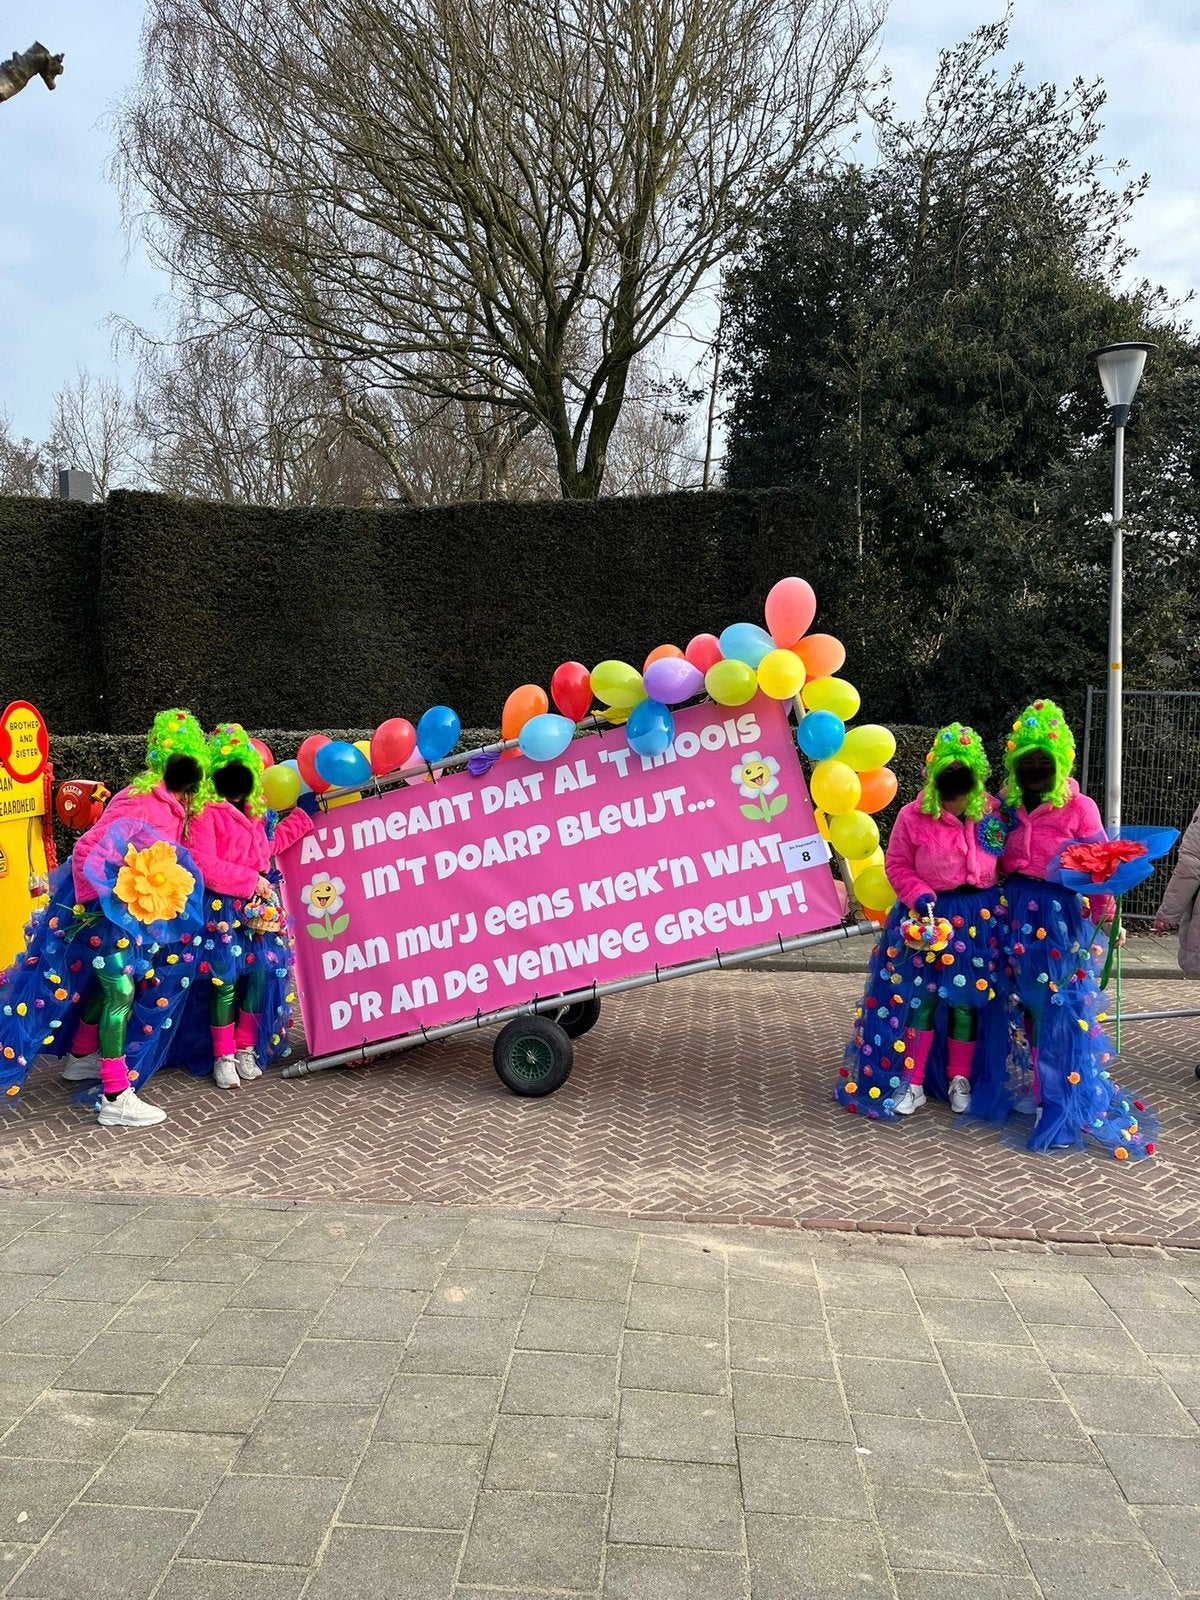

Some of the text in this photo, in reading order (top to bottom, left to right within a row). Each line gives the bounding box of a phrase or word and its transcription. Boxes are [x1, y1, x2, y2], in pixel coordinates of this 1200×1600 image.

[9, 720, 40, 731] BROTHER
[19, 734, 33, 743] AND
[15, 748, 39, 758] SISTER
[481, 772, 544, 816] DAT
[554, 759, 597, 795] AL
[434, 824, 551, 880] DOARP
[802, 851, 811, 862] 8
[321, 936, 390, 980] DAN
[701, 833, 782, 878] WAT
[330, 991, 384, 1031] D'R
[390, 975, 439, 1015] AN
[443, 963, 489, 1001] DE
